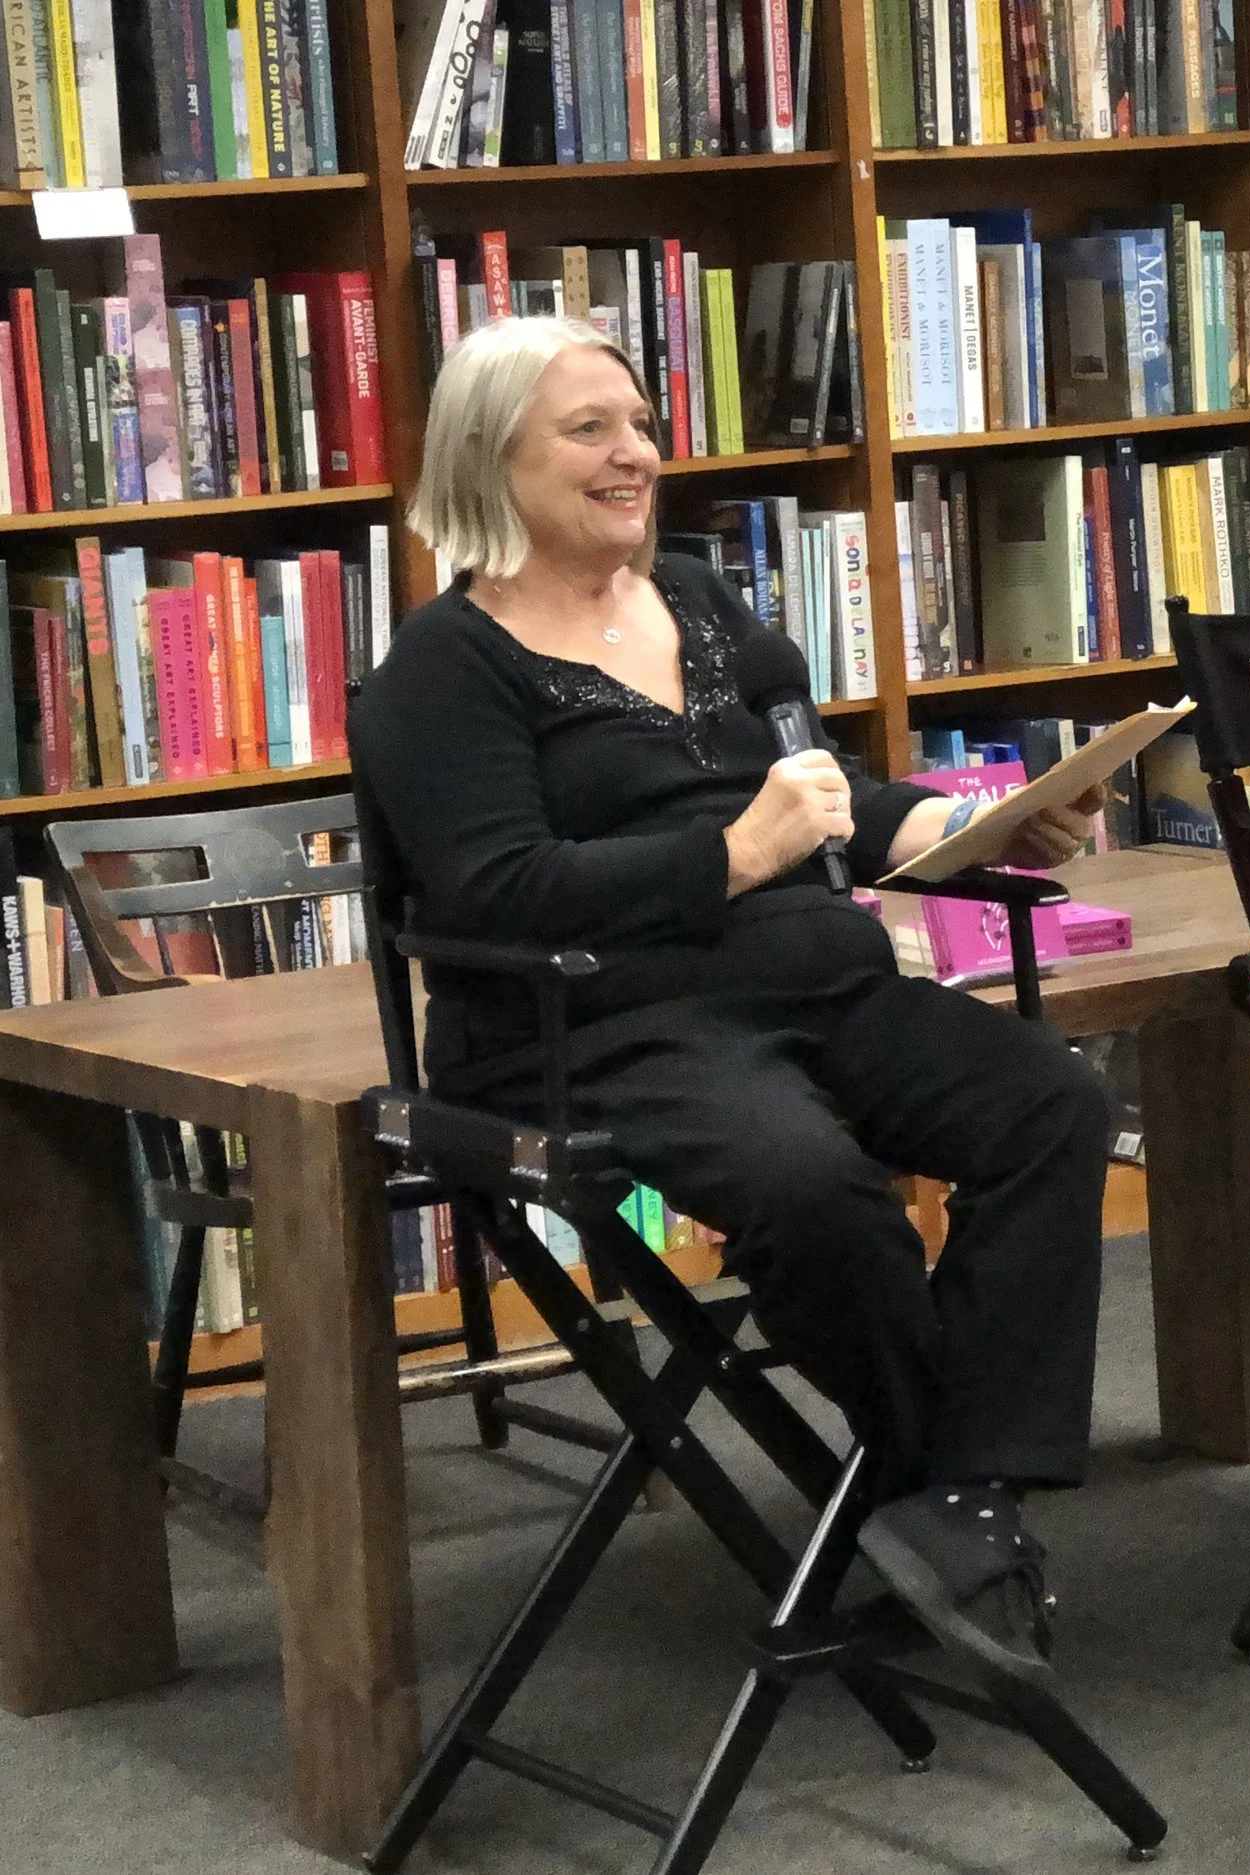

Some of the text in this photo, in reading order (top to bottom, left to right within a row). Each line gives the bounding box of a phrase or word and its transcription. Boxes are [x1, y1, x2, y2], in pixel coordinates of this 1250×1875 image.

[267, 27, 279, 58] ART
[268, 64, 280, 84] OF
[551, 6, 566, 130] STREET ART AND GRAFFITI
[774, 28, 788, 72] SACHS
[1187, 30, 1200, 98] PASSAGES
[187, 84, 199, 116] ART
[564, 62, 572, 92] ATLAS
[776, 75, 789, 116] GUIDE
[16, 79, 37, 155] ARTISTS
[271, 89, 285, 152] NATURE
[895, 252, 912, 341] EXHIBITIONIST
[912, 243, 932, 386] MANET & MORISOT
[934, 243, 952, 385] MANET & MORISOT
[963, 285, 977, 371] MANET DEGAS
[1124, 289, 1144, 359] MONET
[1136, 252, 1168, 359] Monet
[350, 299, 371, 399] AVANT-GARDE
[363, 299, 379, 364] FEMINIST
[667, 295, 684, 373] BASQUIAT
[226, 437, 236, 454] ART
[953, 493, 965, 543] PICASSO
[1210, 475, 1230, 578] MARK ROTHKO
[1099, 531, 1115, 600] Poetry of Light
[78, 547, 109, 655] GIANTS
[204, 593, 217, 629] GREAT
[40, 650, 49, 671] THE
[159, 617, 180, 759] GREAT ART EXPLAINED
[181, 614, 201, 756] GREAT ART EXPLAINED
[209, 675, 225, 739] SCULPTORS
[958, 777, 982, 789] THE
[1155, 807, 1213, 845] Turner
